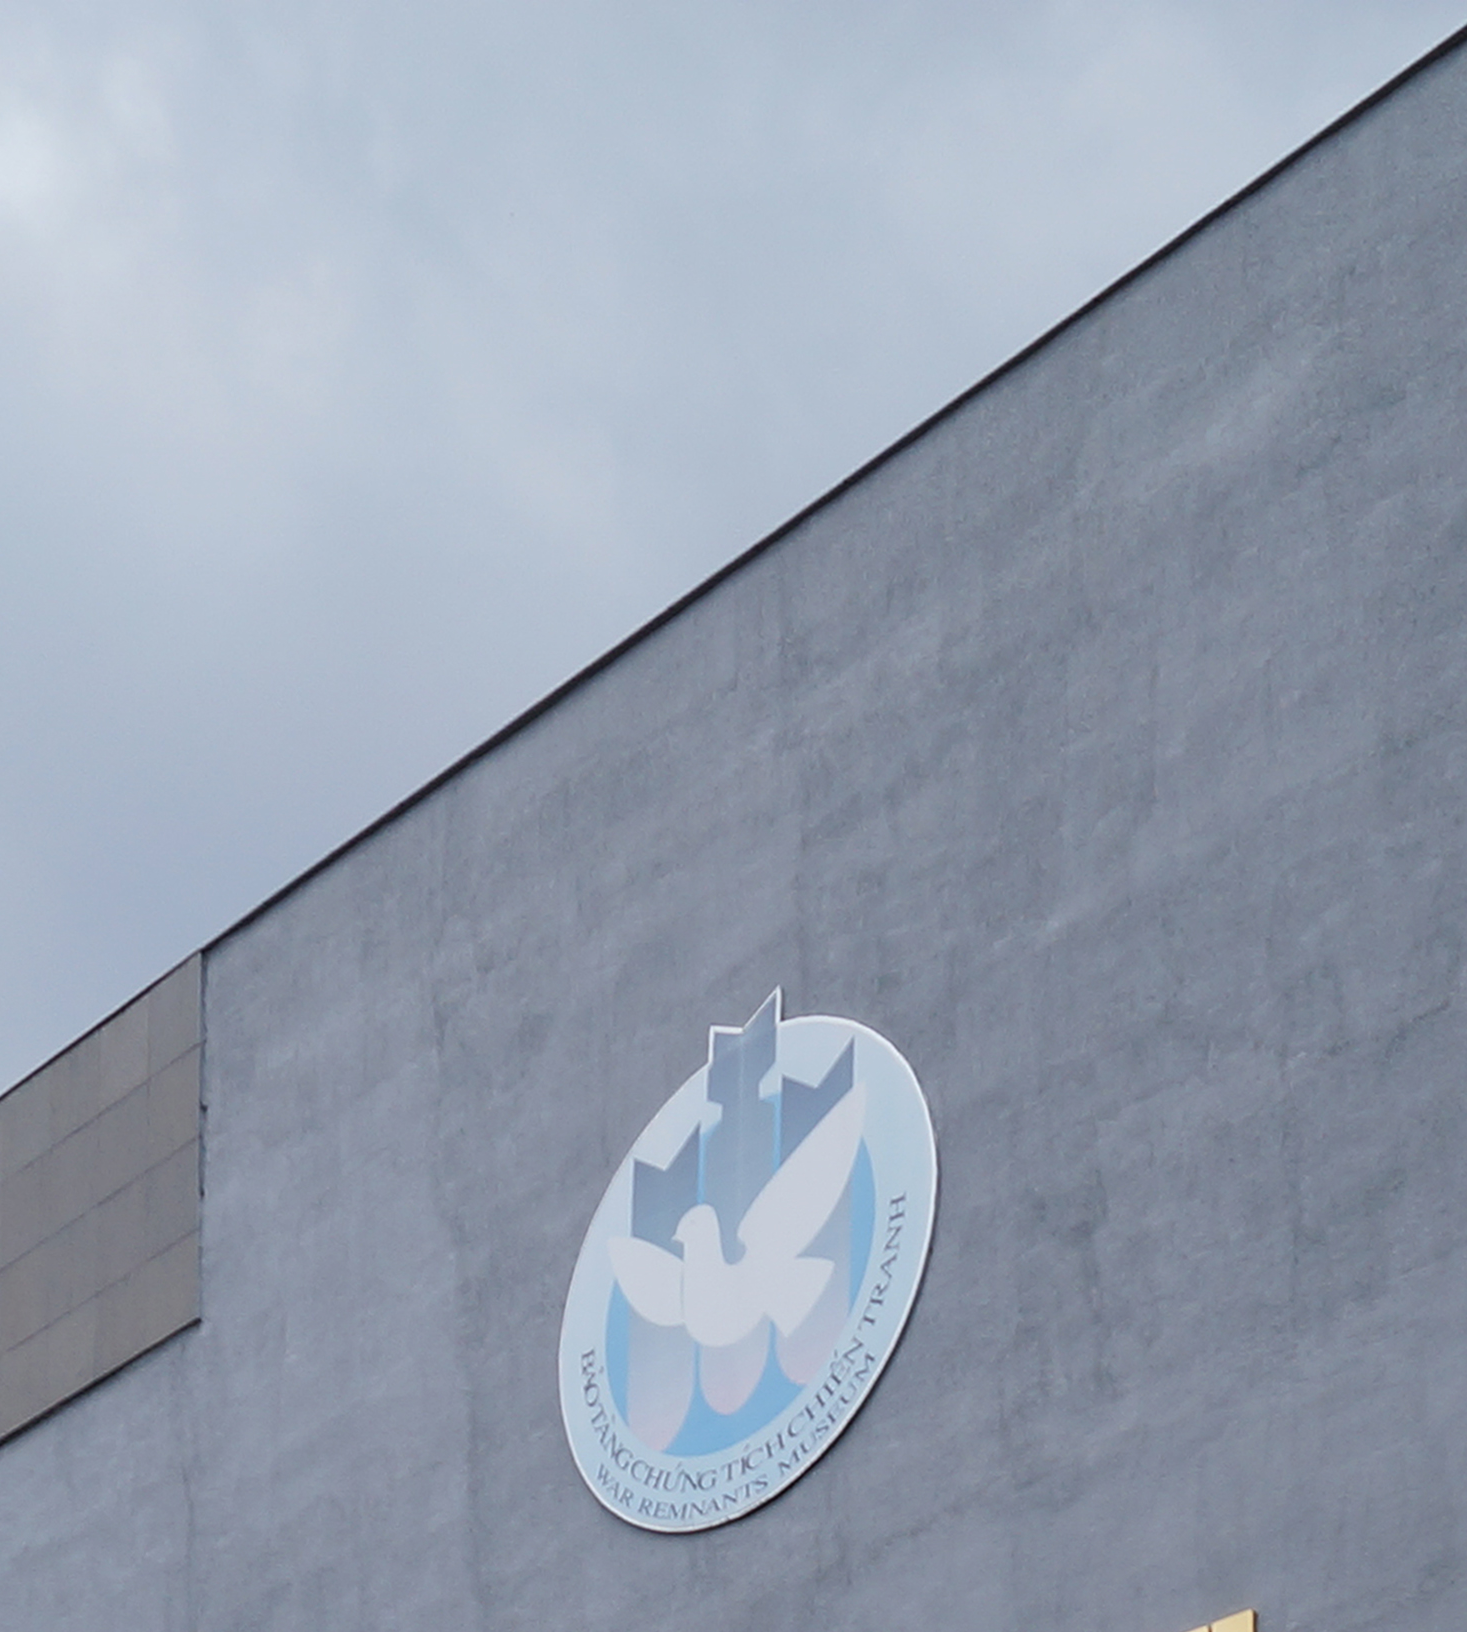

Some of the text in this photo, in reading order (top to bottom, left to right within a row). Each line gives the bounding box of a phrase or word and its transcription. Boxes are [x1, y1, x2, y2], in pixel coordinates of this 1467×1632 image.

[581, 1191, 907, 1493] BẢO TÀNG CHỨNG TÍCH CHIẾN TRANH
[596, 1352, 876, 1520] WAR REMNANTS MUSEUM
